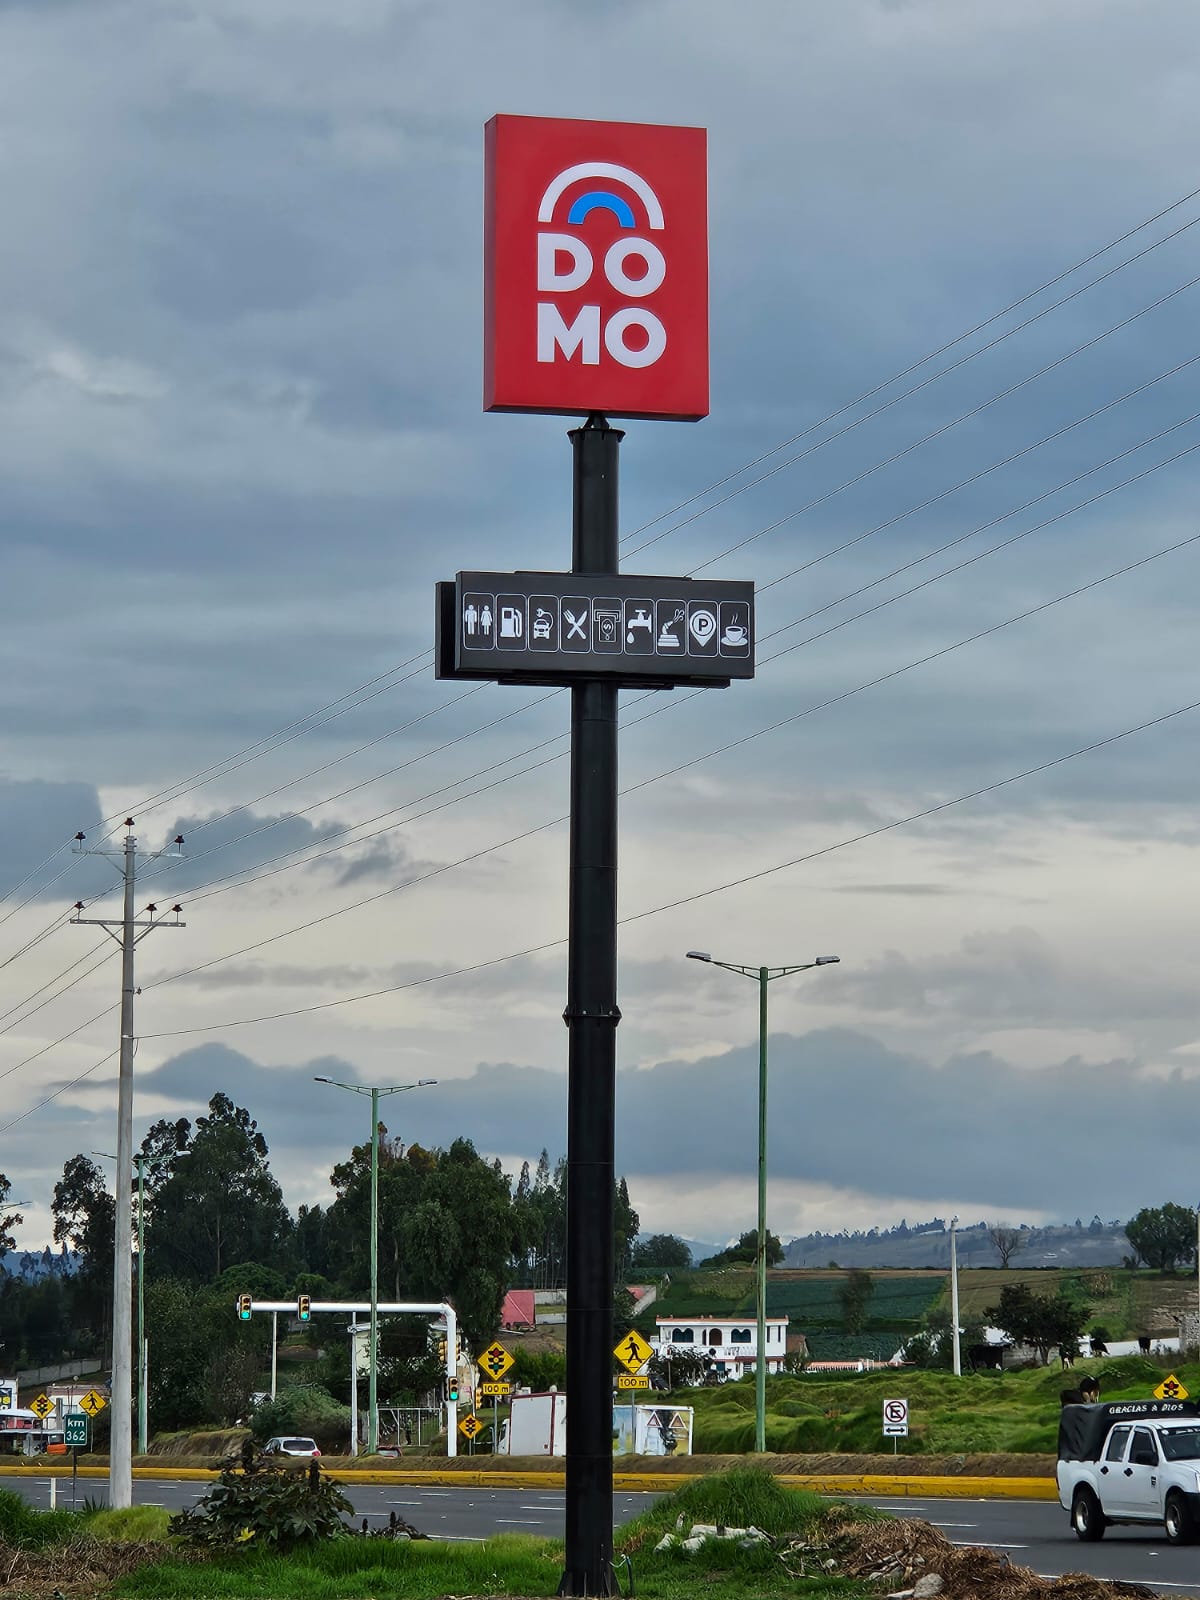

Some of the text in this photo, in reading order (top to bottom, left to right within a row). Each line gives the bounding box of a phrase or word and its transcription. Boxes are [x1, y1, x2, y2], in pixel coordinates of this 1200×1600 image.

[537, 232, 666, 297] DO
[537, 302, 667, 368] MO
[698, 618, 709, 631] P
[619, 1378, 637, 1387] 100
[484, 1385, 499, 1393] 100
[1108, 1403, 1184, 1415] GRACIAS A DIOS
[67, 1418, 85, 1428] km
[66, 1430, 86, 1441] 362
